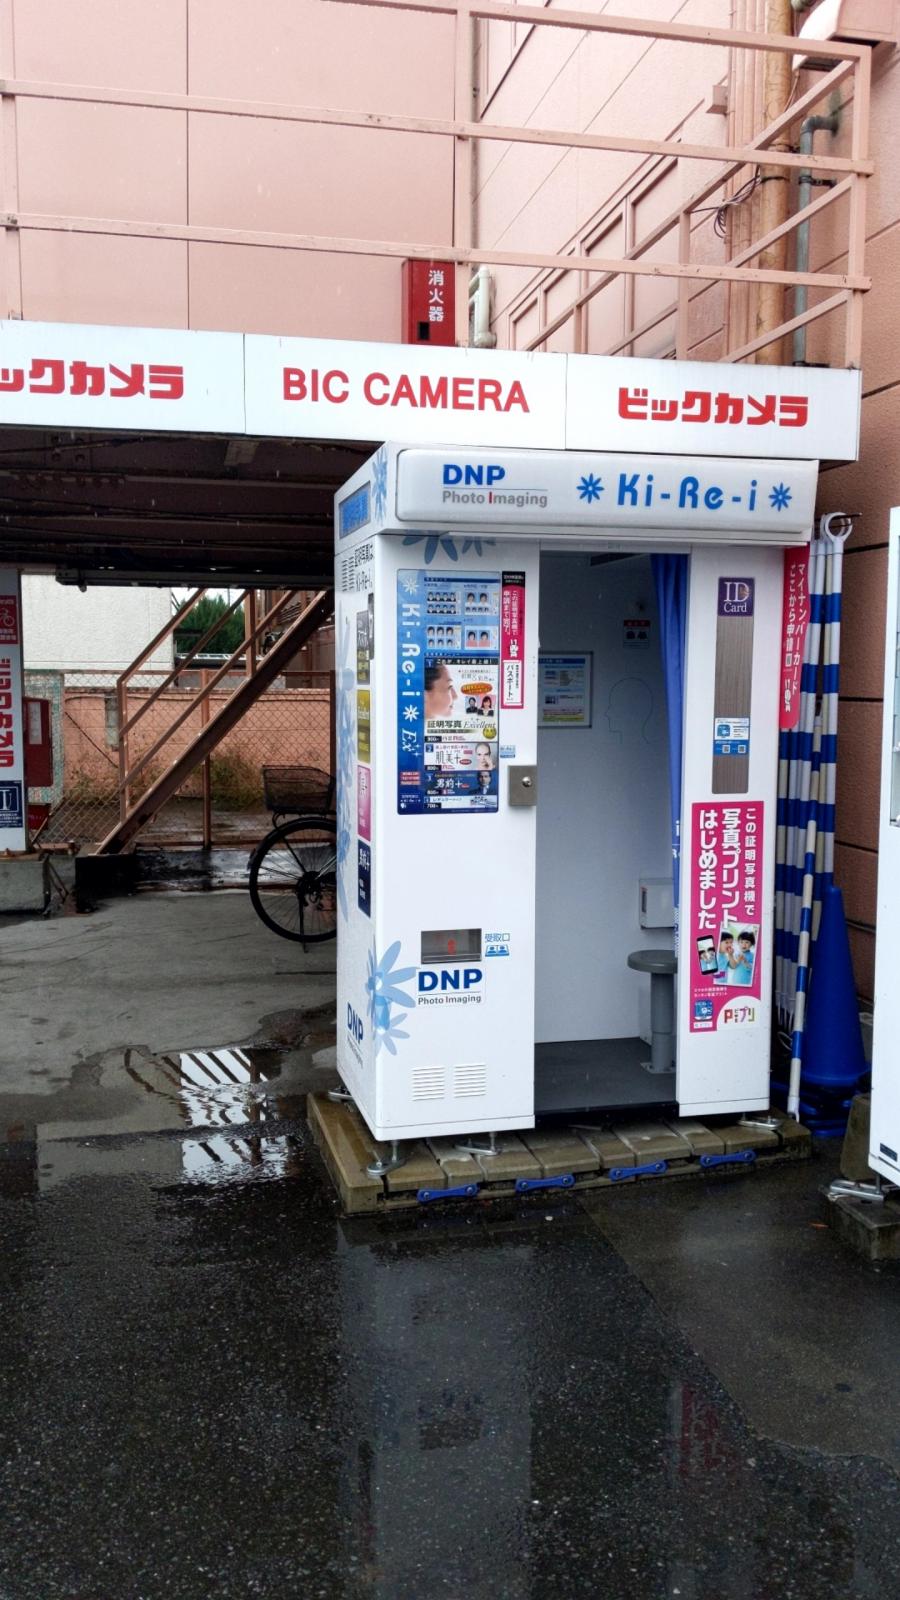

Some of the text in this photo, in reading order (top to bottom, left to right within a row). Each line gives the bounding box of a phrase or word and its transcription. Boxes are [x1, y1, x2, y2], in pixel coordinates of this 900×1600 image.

[428, 269, 444, 322] 消火器
[283, 367, 530, 413] BIC CAMERA
[618, 387, 809, 428] ビックカメラ
[442, 464, 505, 486] DNP
[617, 472, 758, 511] Ki-Re-i
[442, 490, 548, 508] Photo Imaging
[723, 581, 750, 602] ID
[723, 602, 747, 613] Card
[402, 603, 420, 696] Ki-Re-i
[698, 809, 718, 929] はじめました
[721, 808, 742, 929] 写真プリント
[744, 808, 757, 916] この証明写真機で
[484, 932, 511, 942] 受取口
[418, 968, 483, 992] DNP
[418, 995, 482, 1005] Photo Imaging
[347, 1001, 364, 1045] DNP
